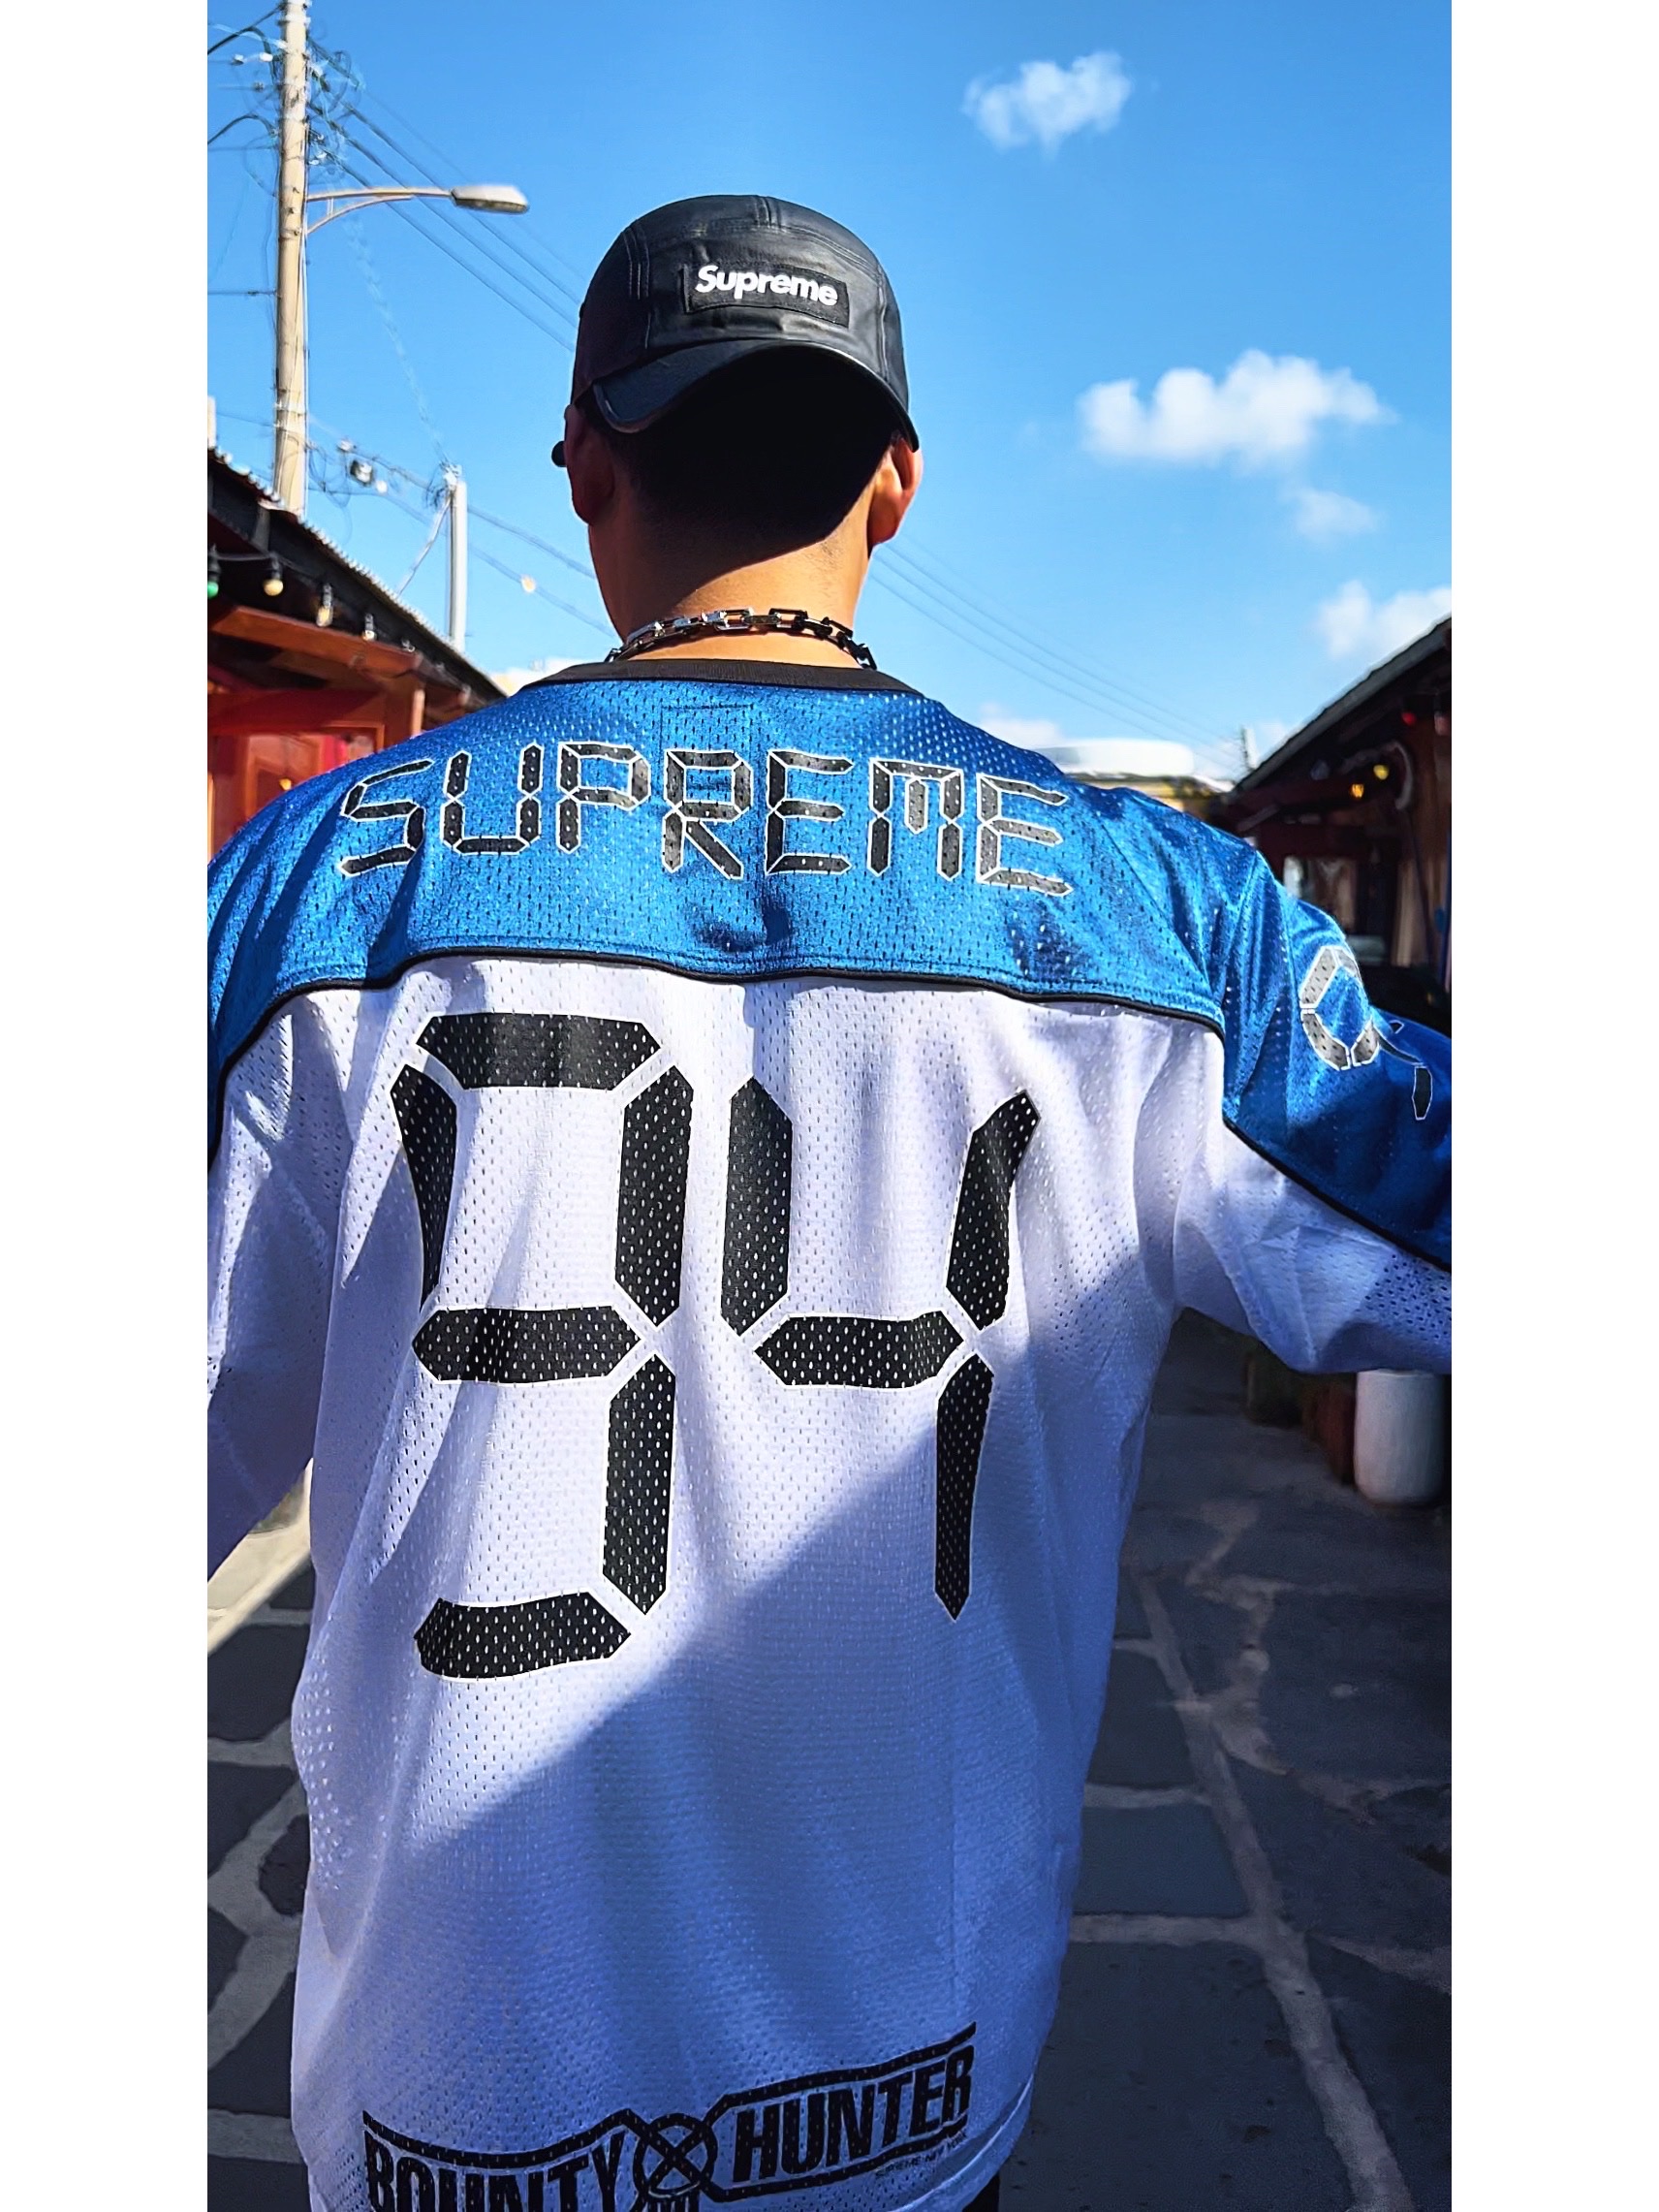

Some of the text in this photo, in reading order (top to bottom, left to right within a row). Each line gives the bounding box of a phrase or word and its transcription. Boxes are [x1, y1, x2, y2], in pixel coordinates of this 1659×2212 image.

[694, 265, 839, 306] Supreme
[339, 742, 1073, 896] SUPREME
[391, 1013, 1039, 1679] 94
[734, 2044, 975, 2182] HUNTER
